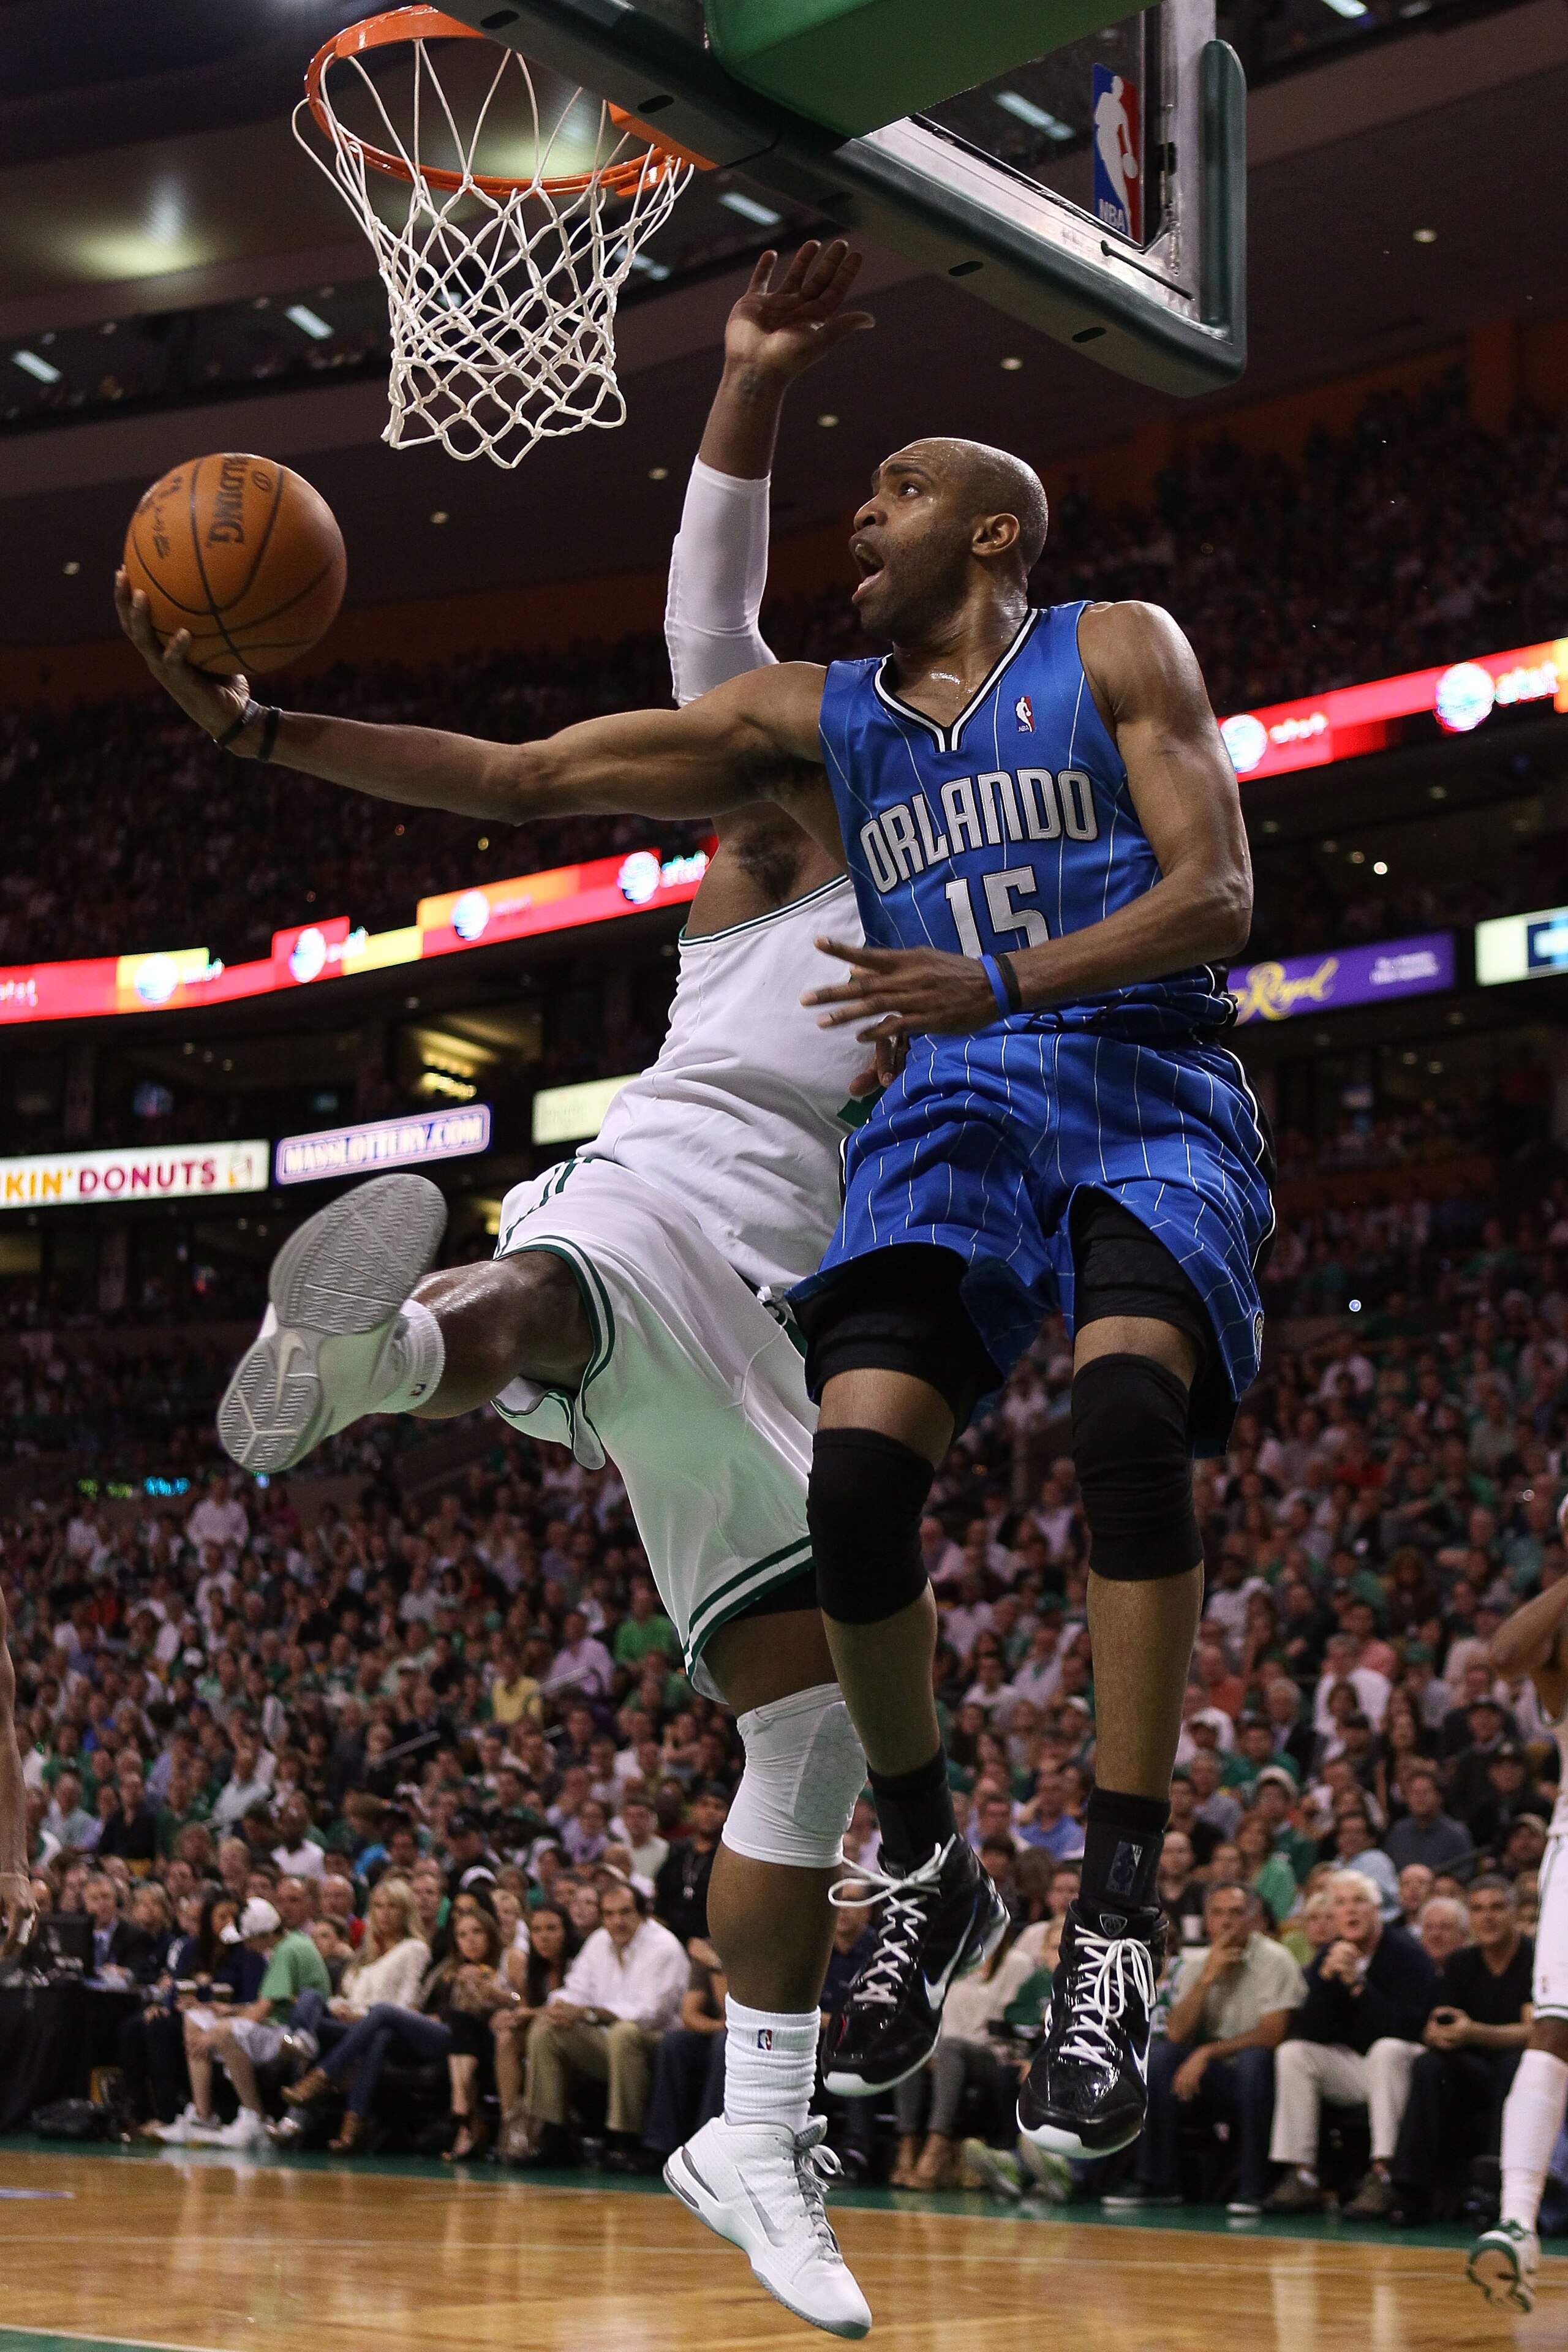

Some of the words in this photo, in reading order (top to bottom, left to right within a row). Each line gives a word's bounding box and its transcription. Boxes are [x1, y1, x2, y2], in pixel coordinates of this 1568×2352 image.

[1099, 198, 1126, 232] NBA
[859, 768, 1098, 894] ORLANDO
[945, 865, 1050, 960] 15
[0, 1166, 73, 1199] KIN'
[79, 1159, 216, 1195] DONUTS
